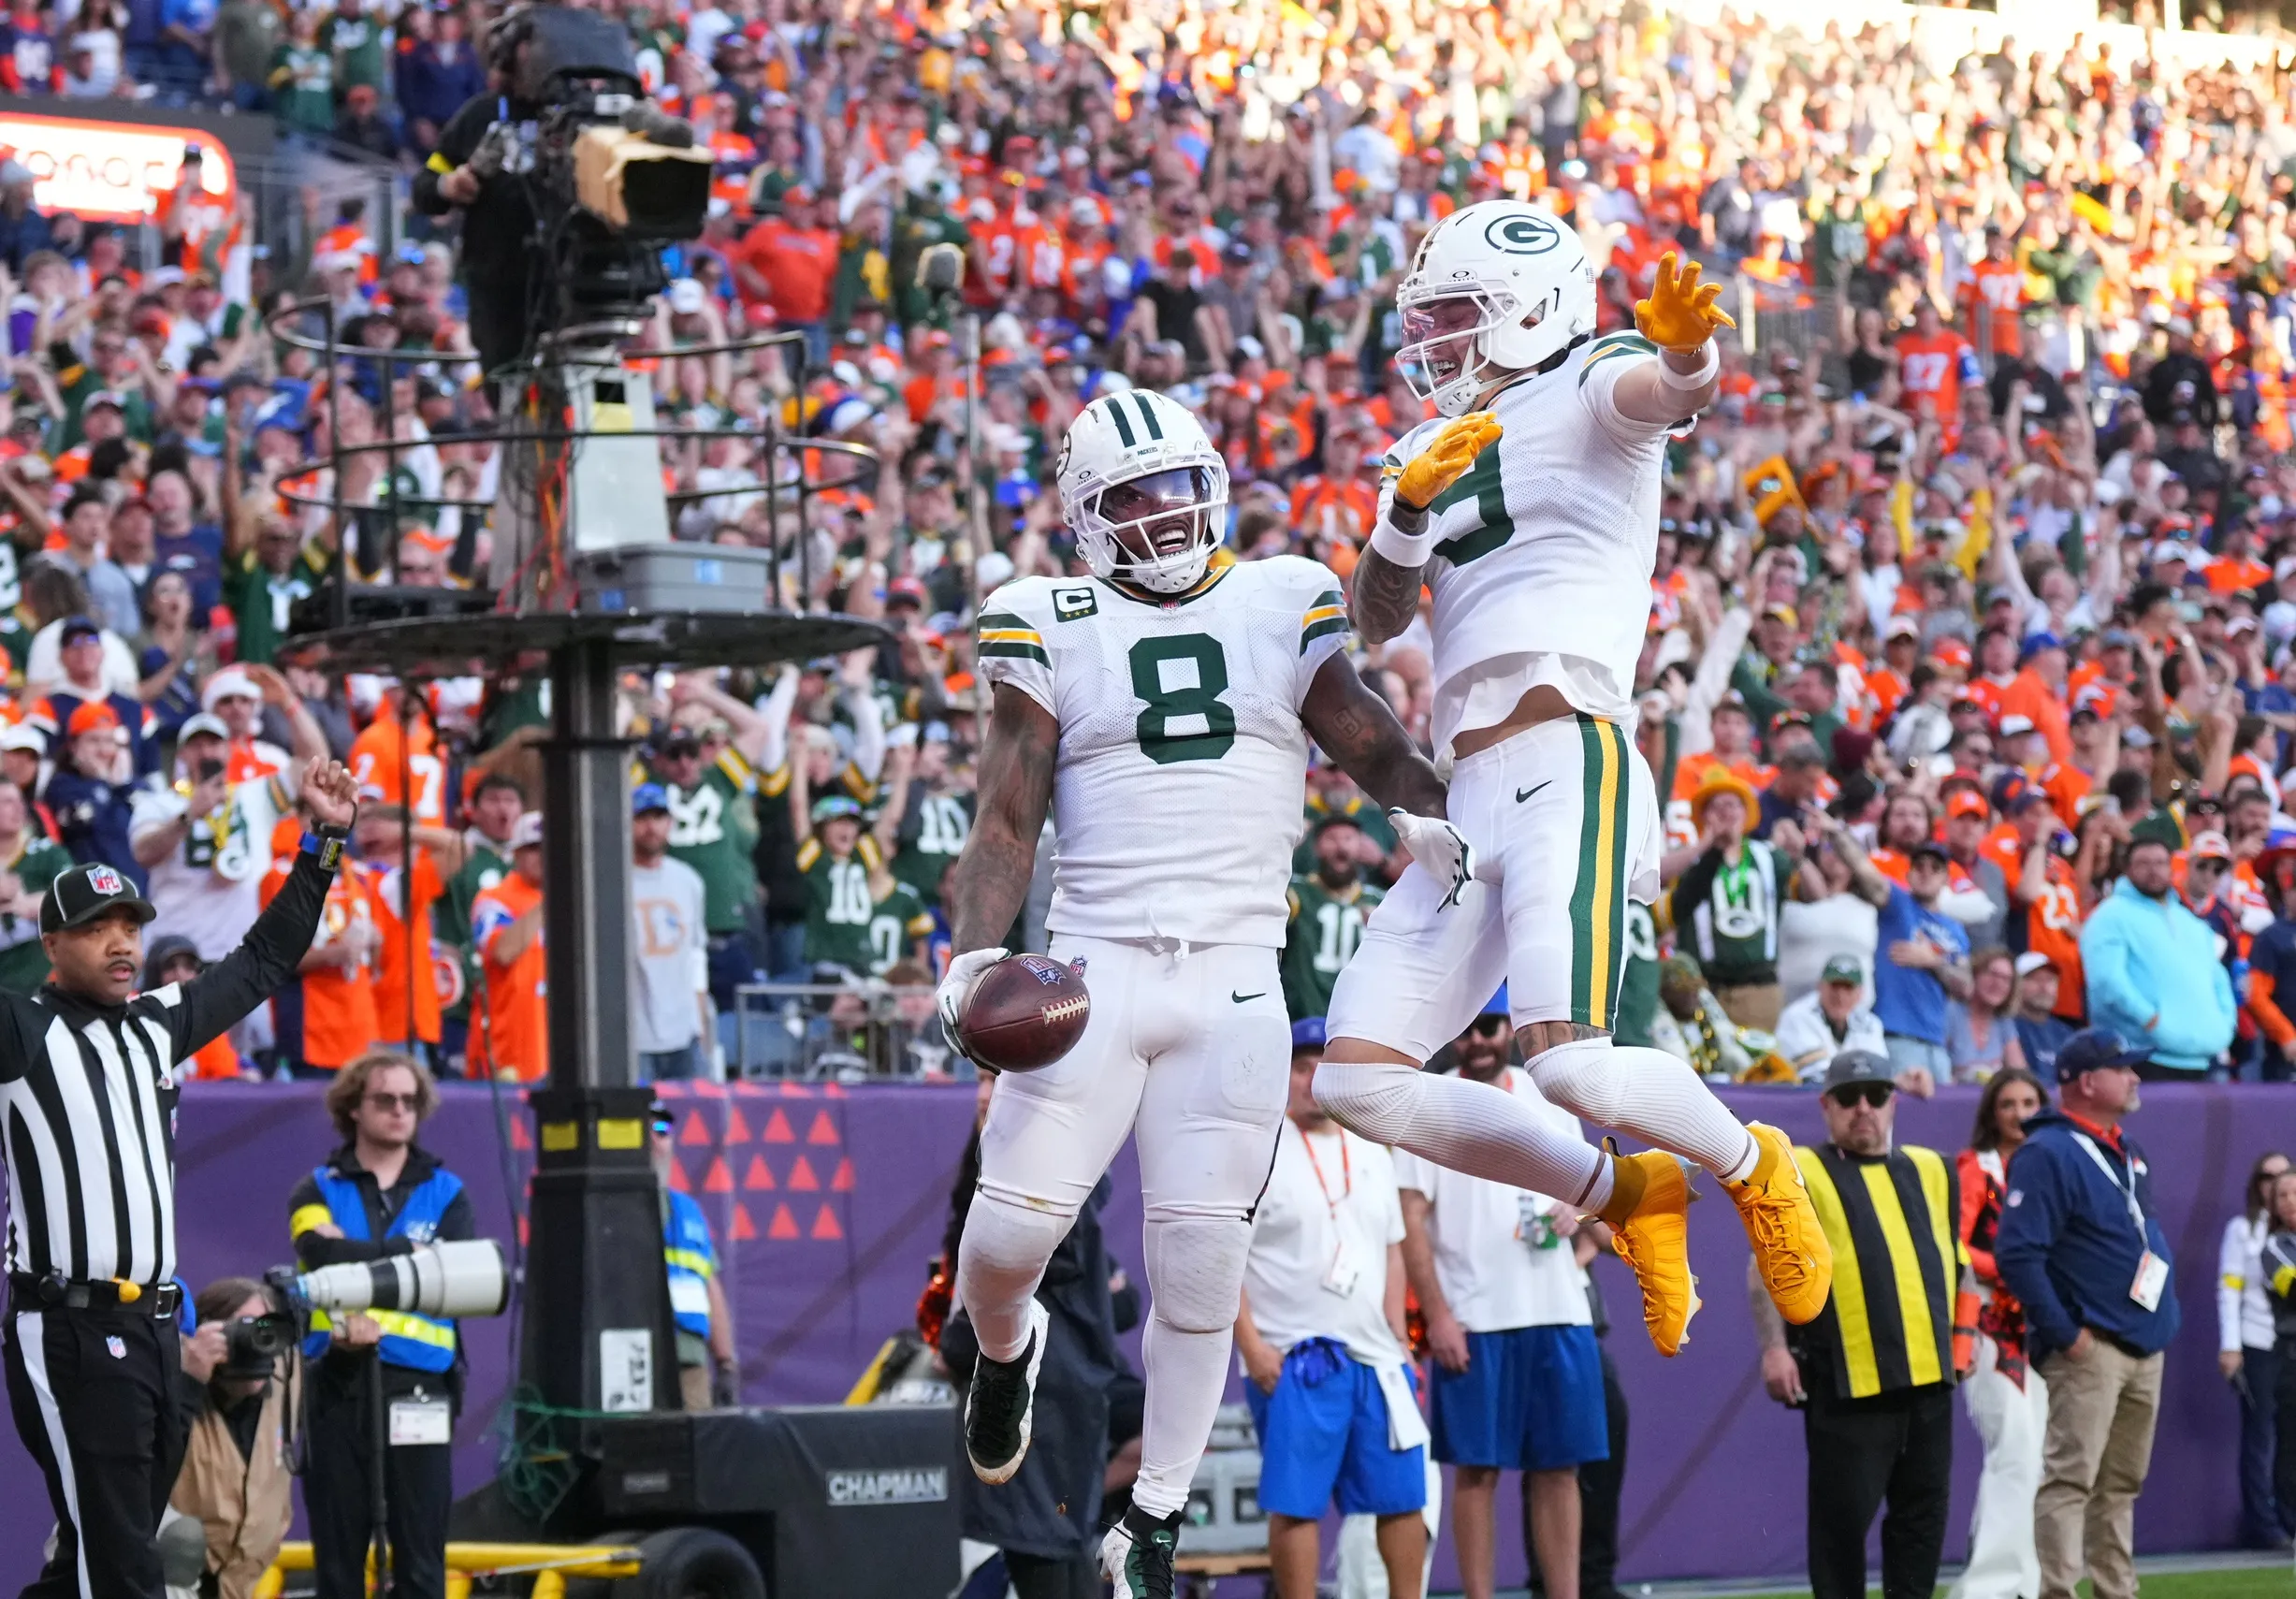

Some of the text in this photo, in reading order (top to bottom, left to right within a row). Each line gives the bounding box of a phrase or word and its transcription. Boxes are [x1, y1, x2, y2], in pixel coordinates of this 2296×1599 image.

[1137, 446, 1158, 457] PACKERS
[1056, 589, 1093, 613] C
[1128, 632, 1236, 764] 8
[1069, 964, 1083, 976] NFL
[828, 1472, 943, 1501] CHAPMAN
